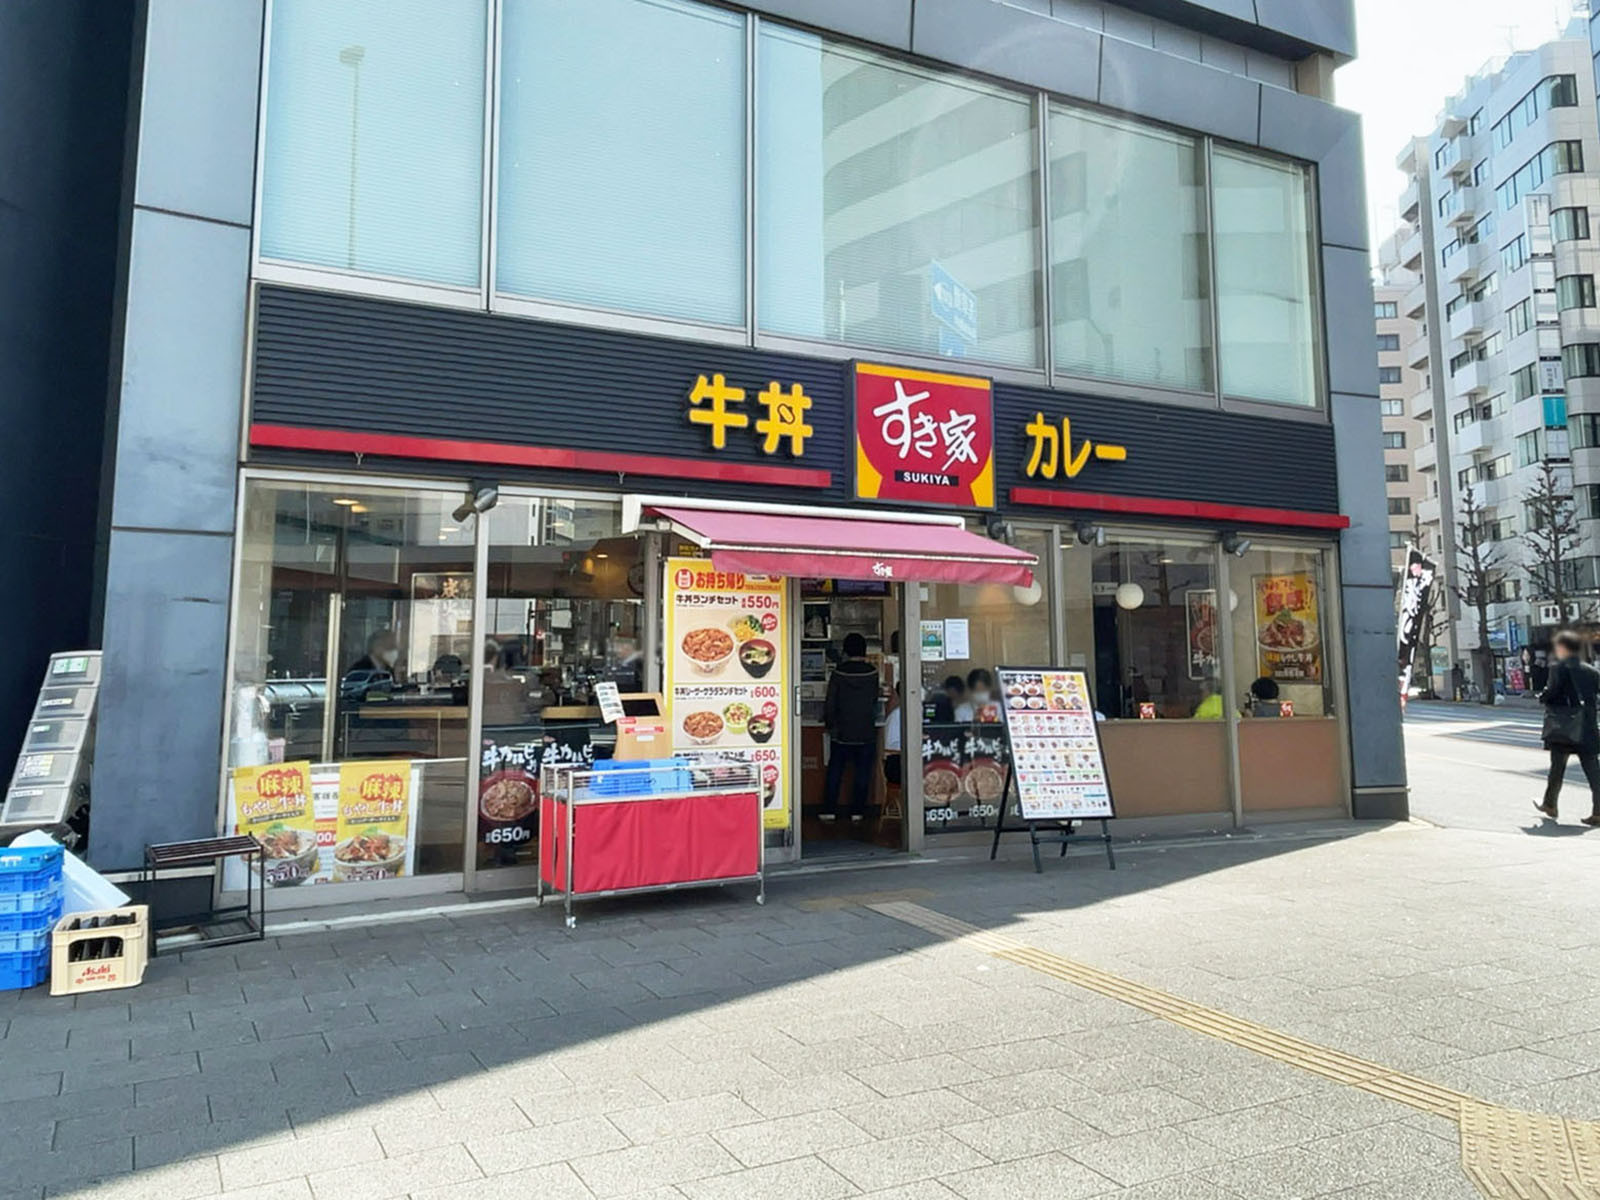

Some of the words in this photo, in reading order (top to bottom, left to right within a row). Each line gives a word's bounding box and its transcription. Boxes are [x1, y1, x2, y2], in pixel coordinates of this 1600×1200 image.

[689, 373, 814, 457] 牛丼
[872, 379, 979, 471] すき家
[1025, 411, 1128, 480] カレー
[902, 471, 951, 486] SUKIYA
[676, 594, 738, 605] 牛丼ランチセット
[695, 572, 745, 590] お持ち帰り
